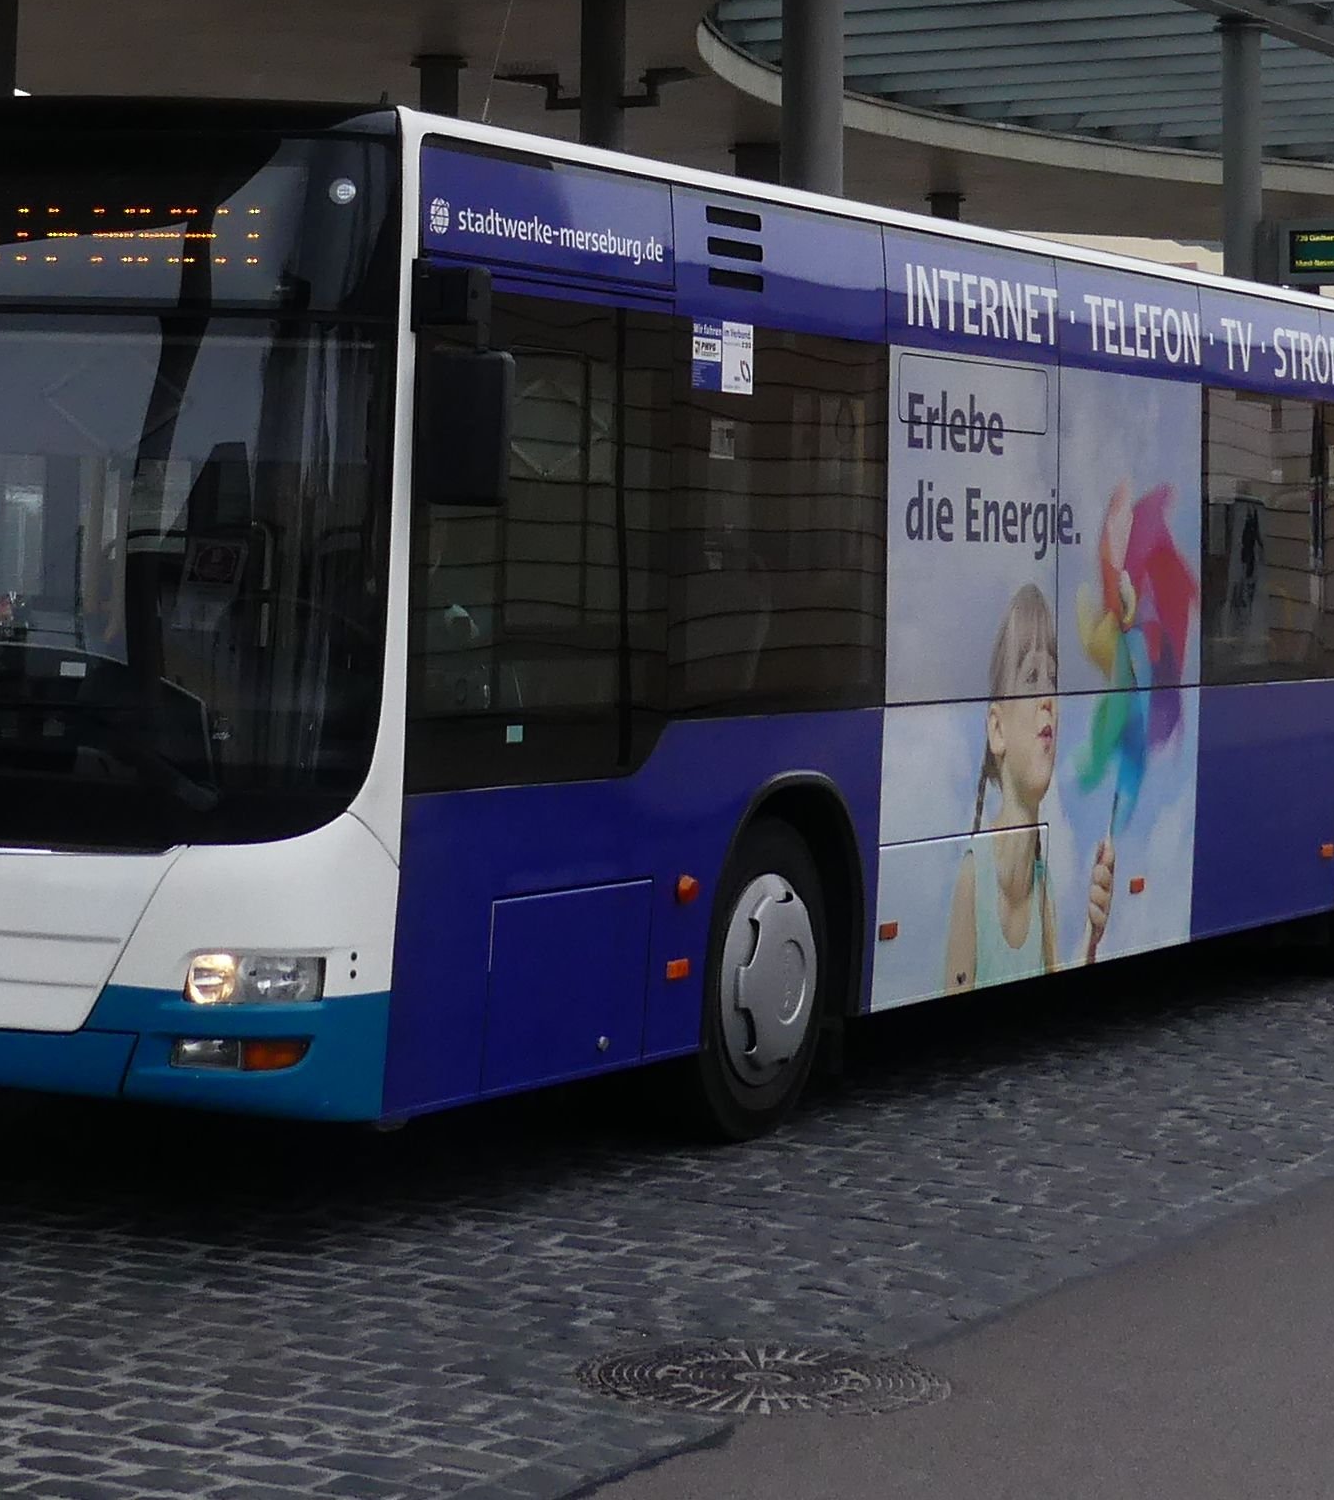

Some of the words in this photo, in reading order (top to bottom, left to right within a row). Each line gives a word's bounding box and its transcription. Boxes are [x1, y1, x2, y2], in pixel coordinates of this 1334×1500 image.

[458, 208, 664, 266] stadtwerke-merseburg.de
[905, 263, 1058, 346] INTERNET
[1083, 294, 1202, 366] TELEFON
[1220, 318, 1253, 373] TV
[907, 390, 1004, 456] Erlebe
[905, 479, 954, 543] die
[965, 487, 1082, 561] Energie.
